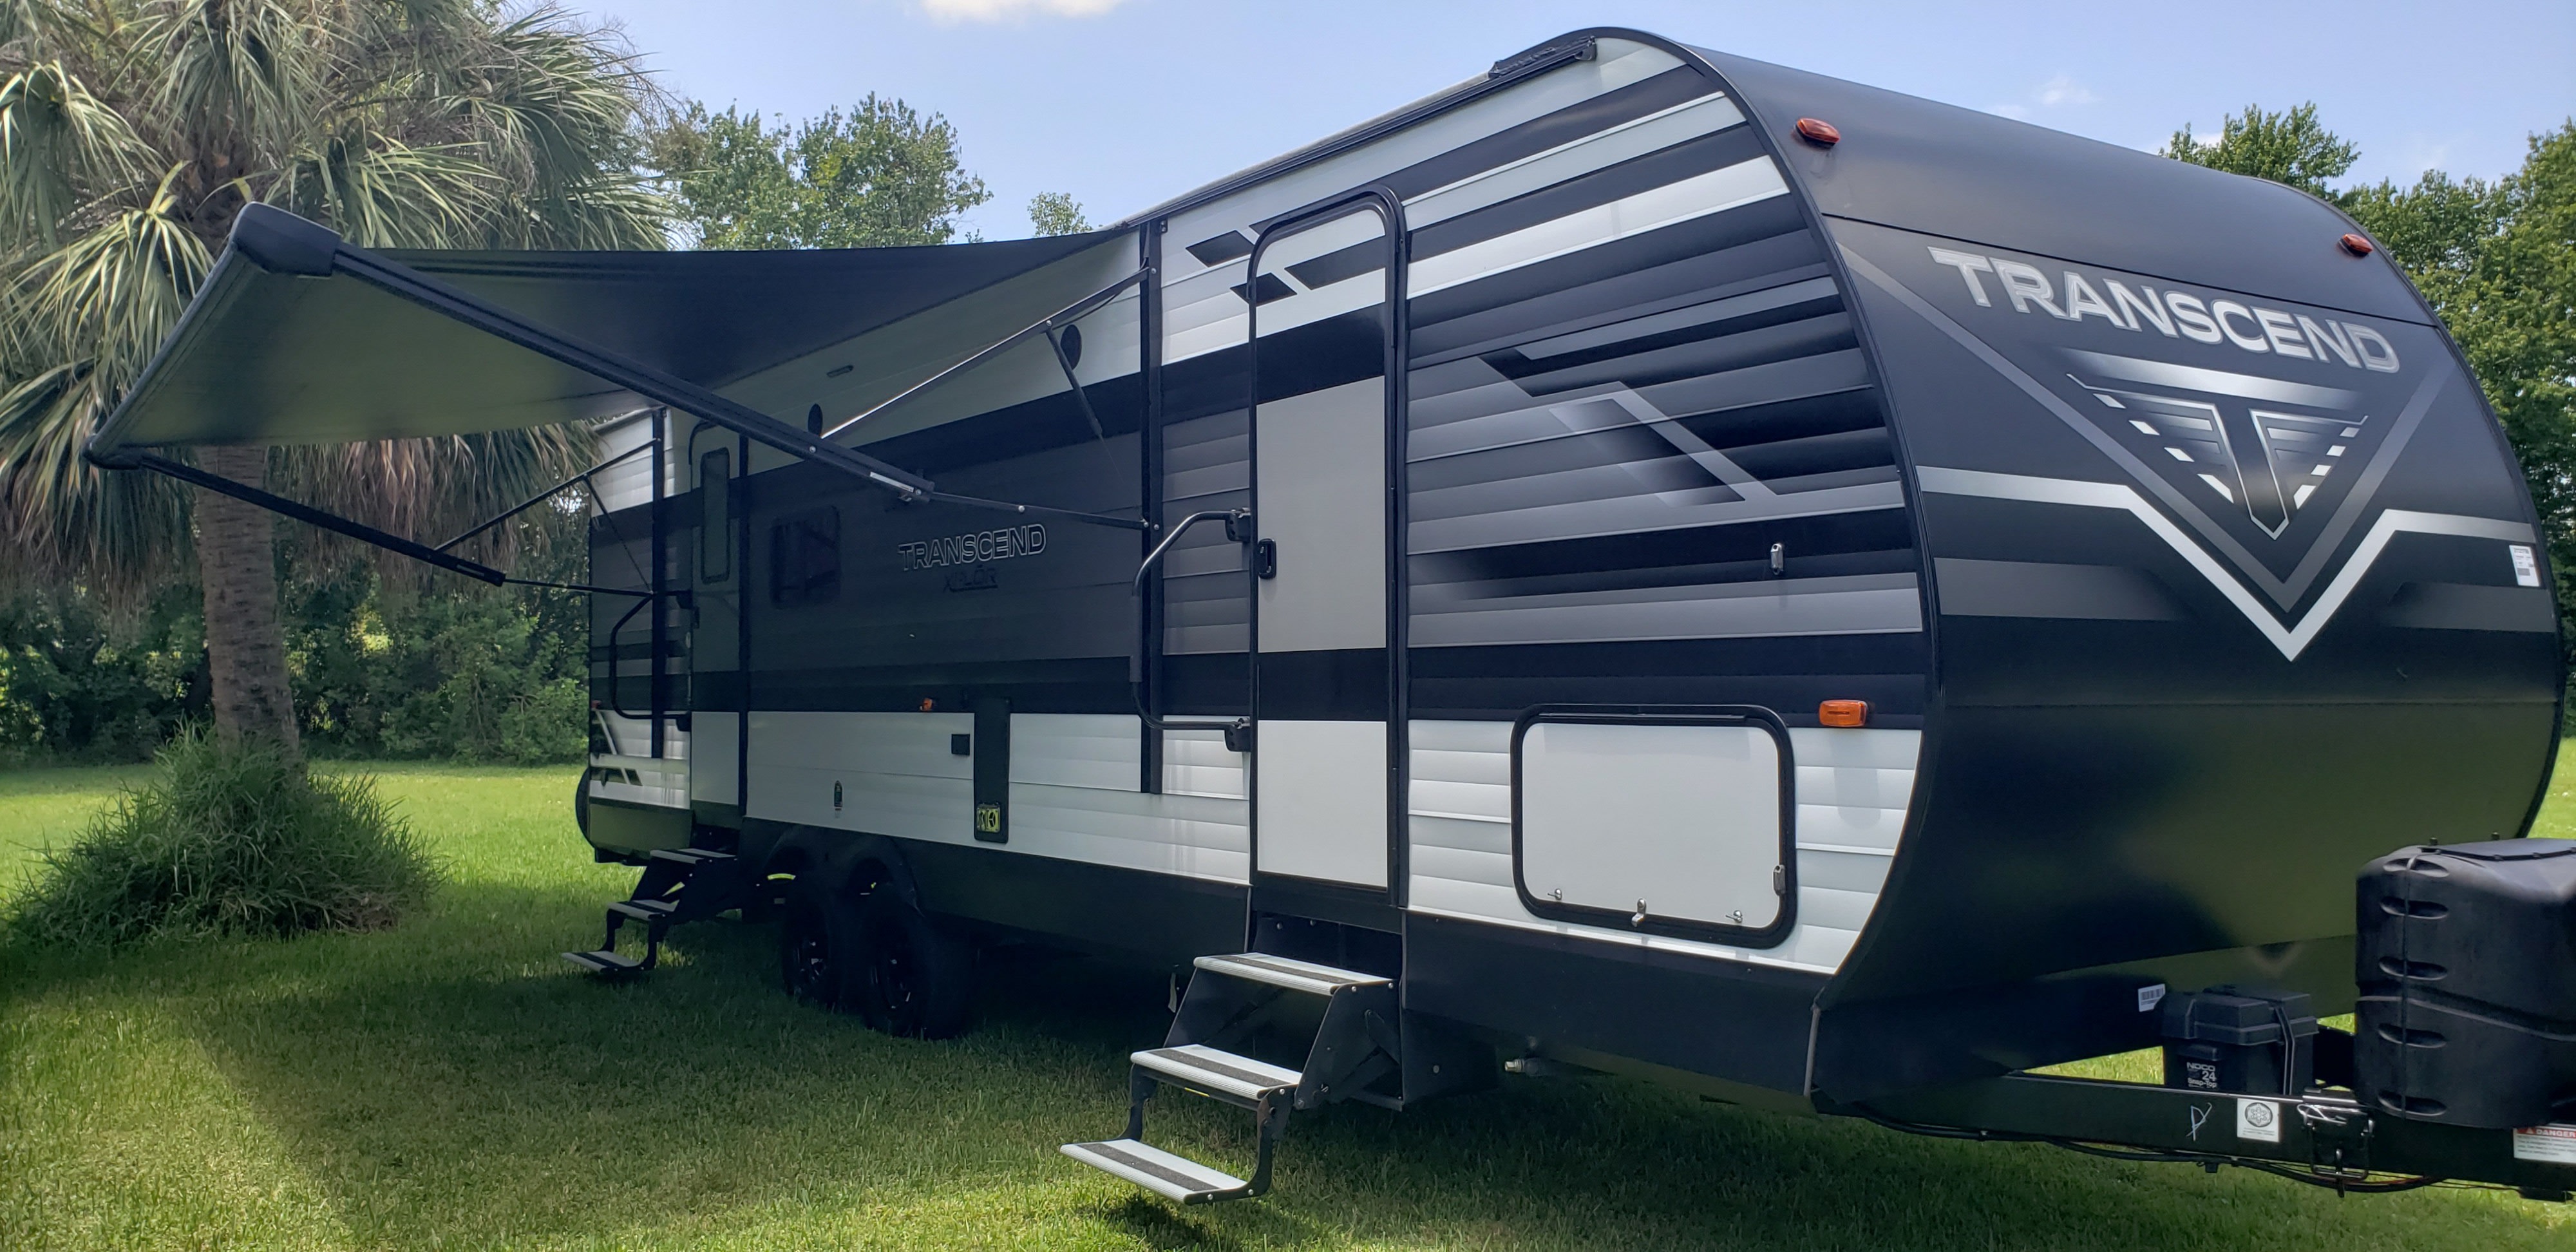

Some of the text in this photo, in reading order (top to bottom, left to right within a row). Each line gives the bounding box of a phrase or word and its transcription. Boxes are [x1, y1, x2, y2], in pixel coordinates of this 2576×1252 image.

[1927, 246, 2400, 374] TRANSCEND
[898, 524, 1046, 571] TRANSCEND
[2186, 1062, 2215, 1071] NOCO
[2202, 1070, 2217, 1081] 24
[2535, 1129, 2576, 1138] DANGER
